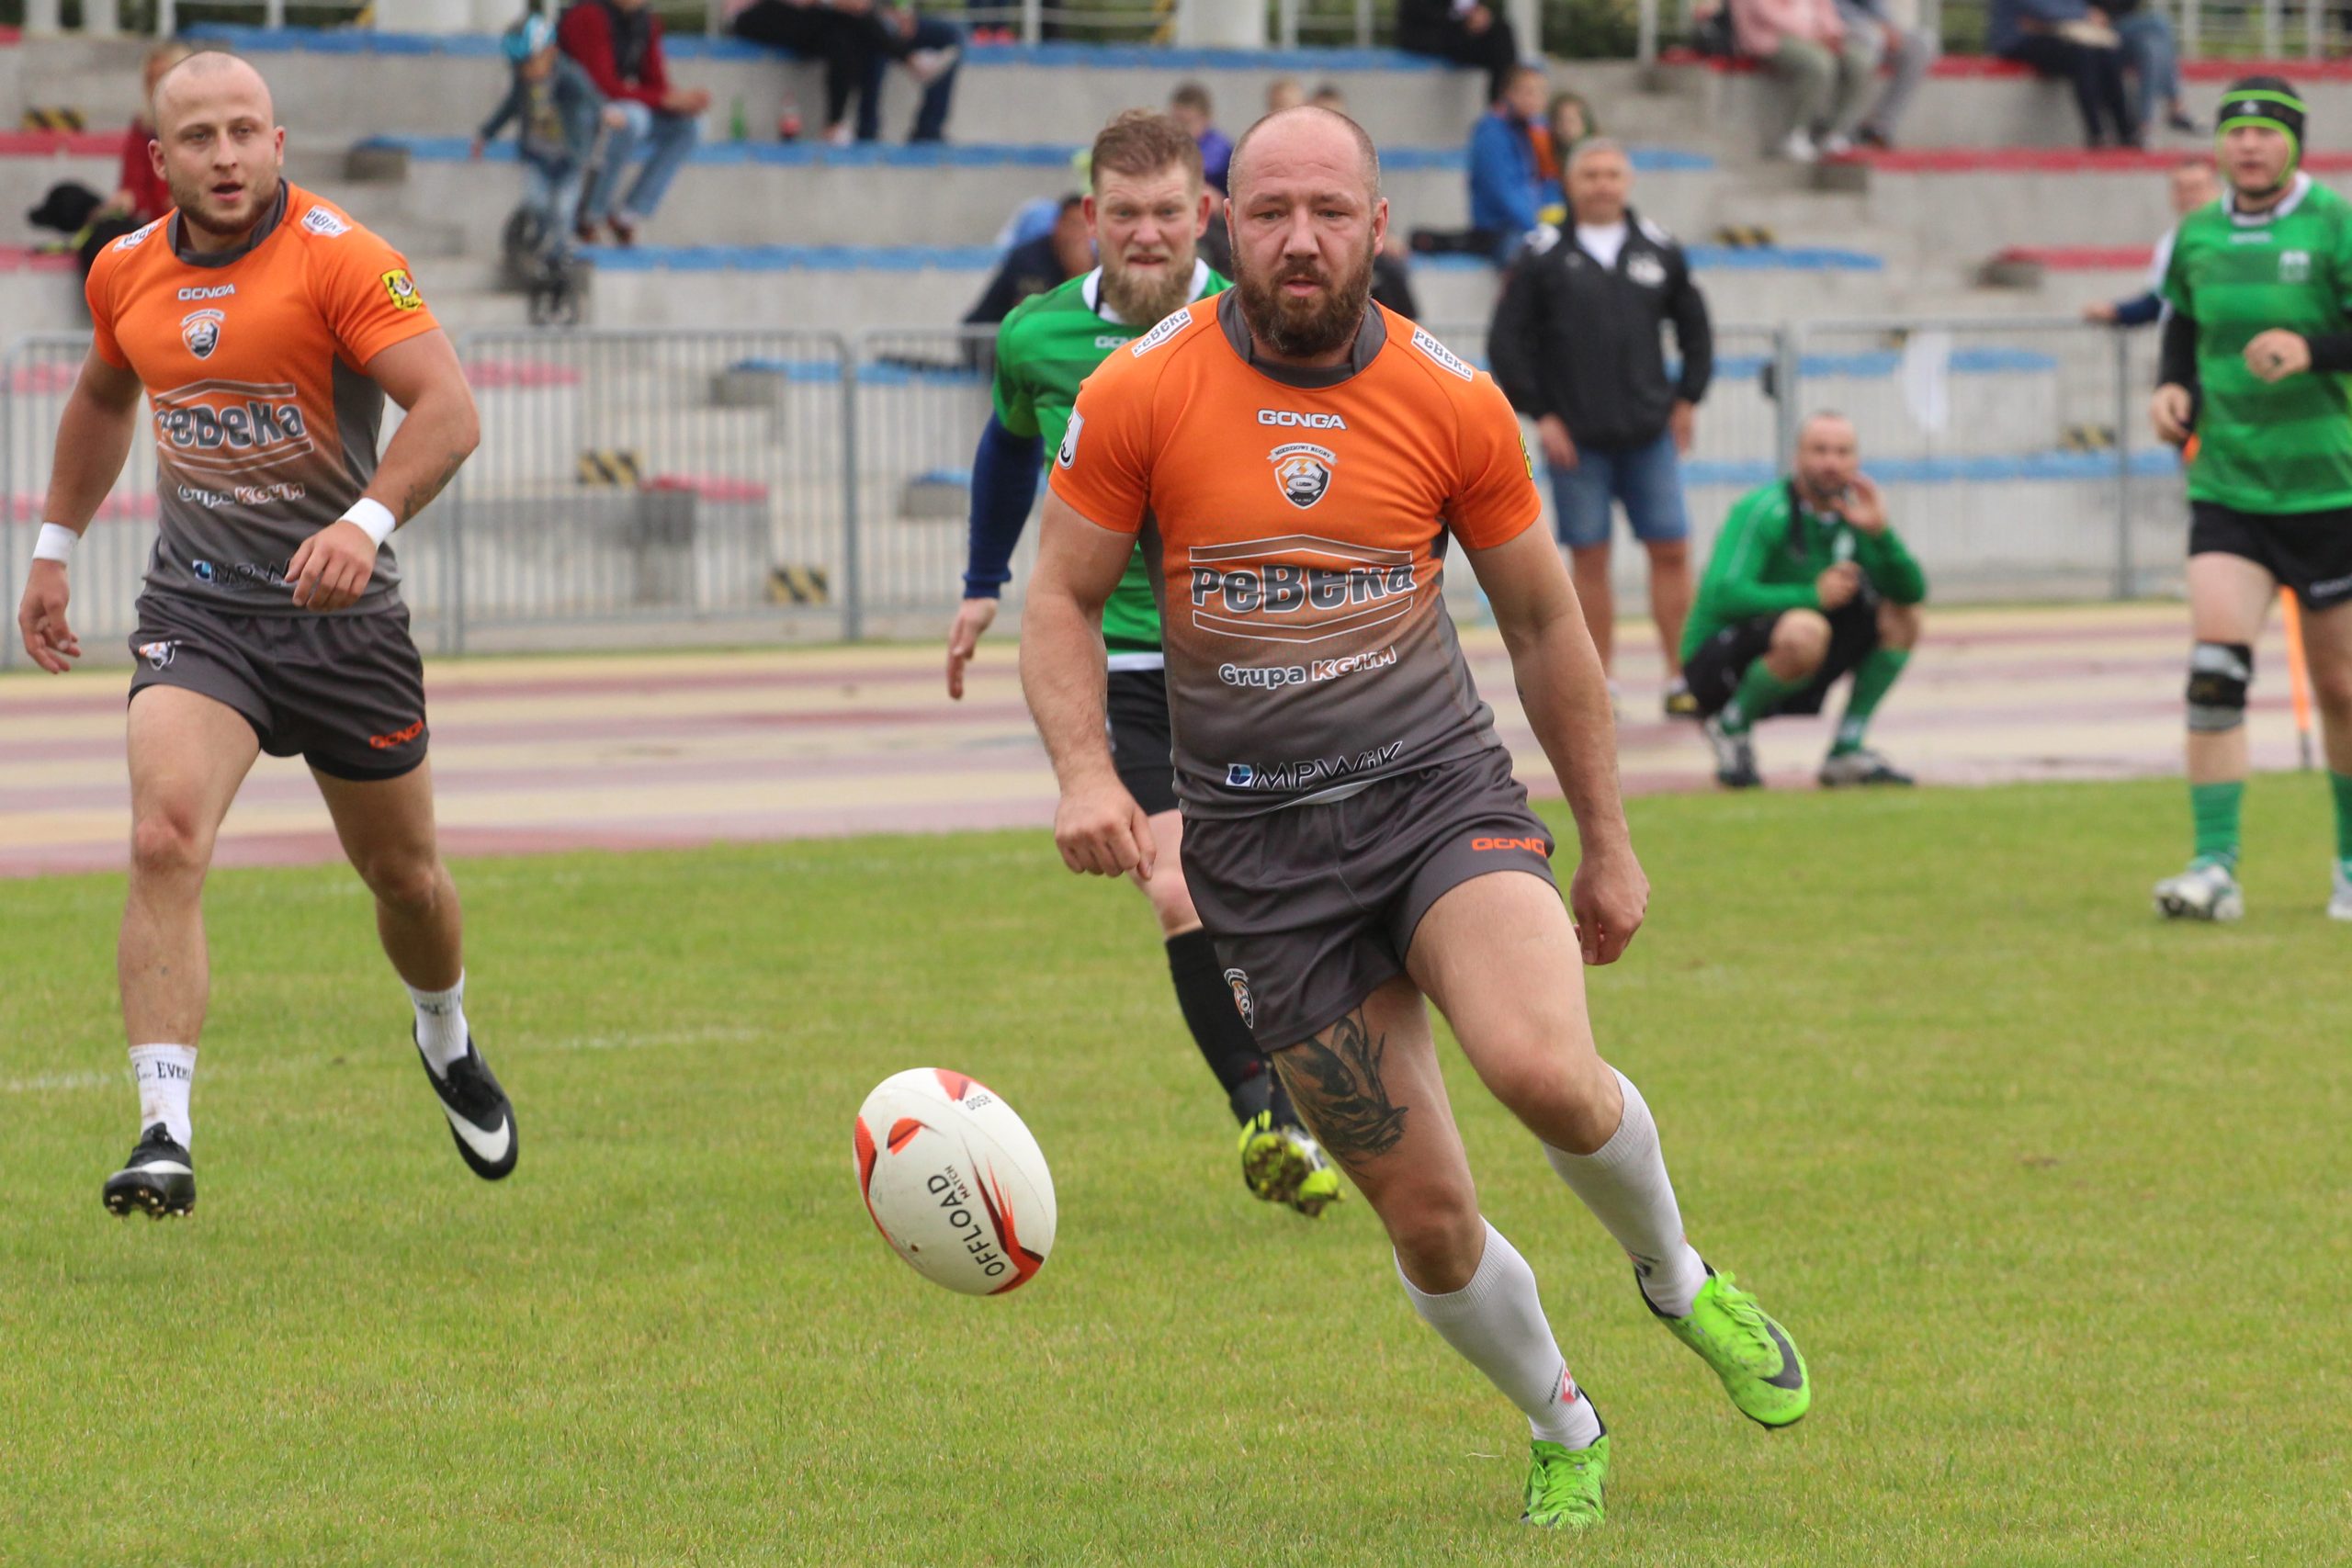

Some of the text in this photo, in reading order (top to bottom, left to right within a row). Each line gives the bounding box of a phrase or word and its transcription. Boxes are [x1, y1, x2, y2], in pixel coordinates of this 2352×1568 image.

[1257, 409, 1347, 430] GONGA
[1219, 646, 1396, 690] Grupa KGHM
[1471, 837, 1545, 858] GONG
[944, 1165, 970, 1199] MATCH
[927, 1174, 1006, 1277] OFFLOAD
